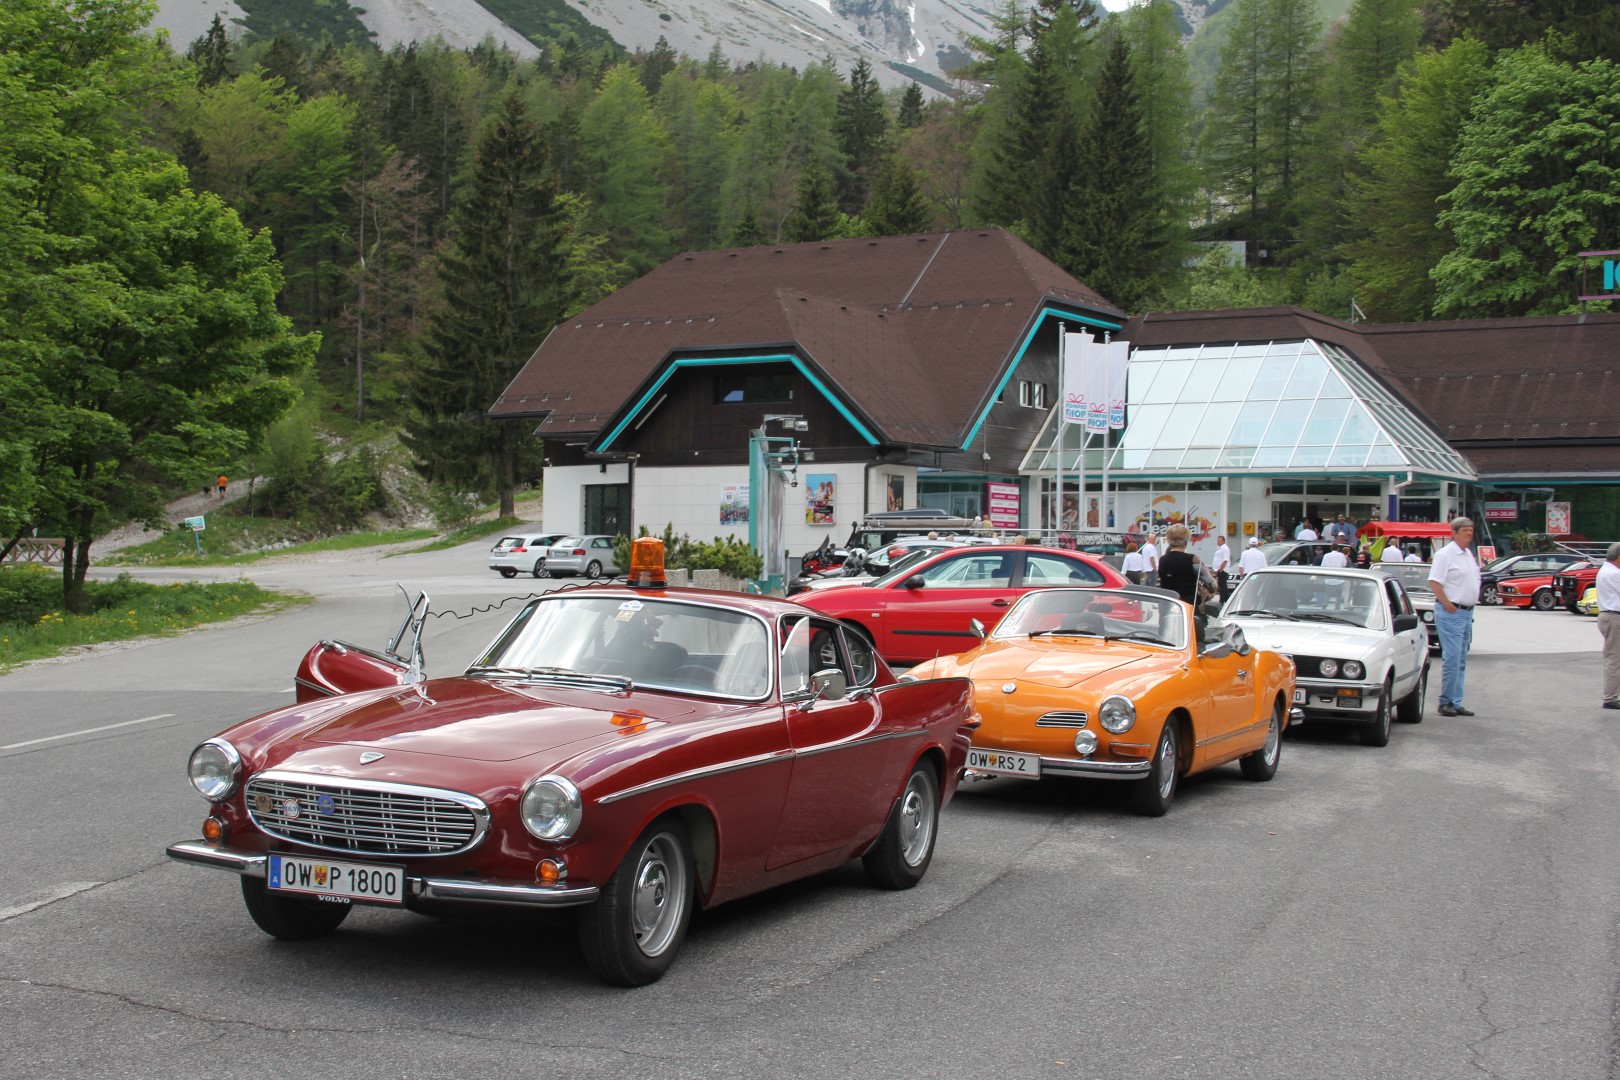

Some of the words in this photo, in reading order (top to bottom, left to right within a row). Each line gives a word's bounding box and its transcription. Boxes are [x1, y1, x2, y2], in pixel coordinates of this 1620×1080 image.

[970, 752, 988, 767] OW
[998, 756, 1014, 770] RS
[1018, 757, 1026, 772] 2
[272, 875, 279, 884] A
[285, 862, 312, 887] OW
[330, 867, 341, 890] P
[347, 868, 396, 896] 1800
[317, 894, 351, 904] VOLVO
